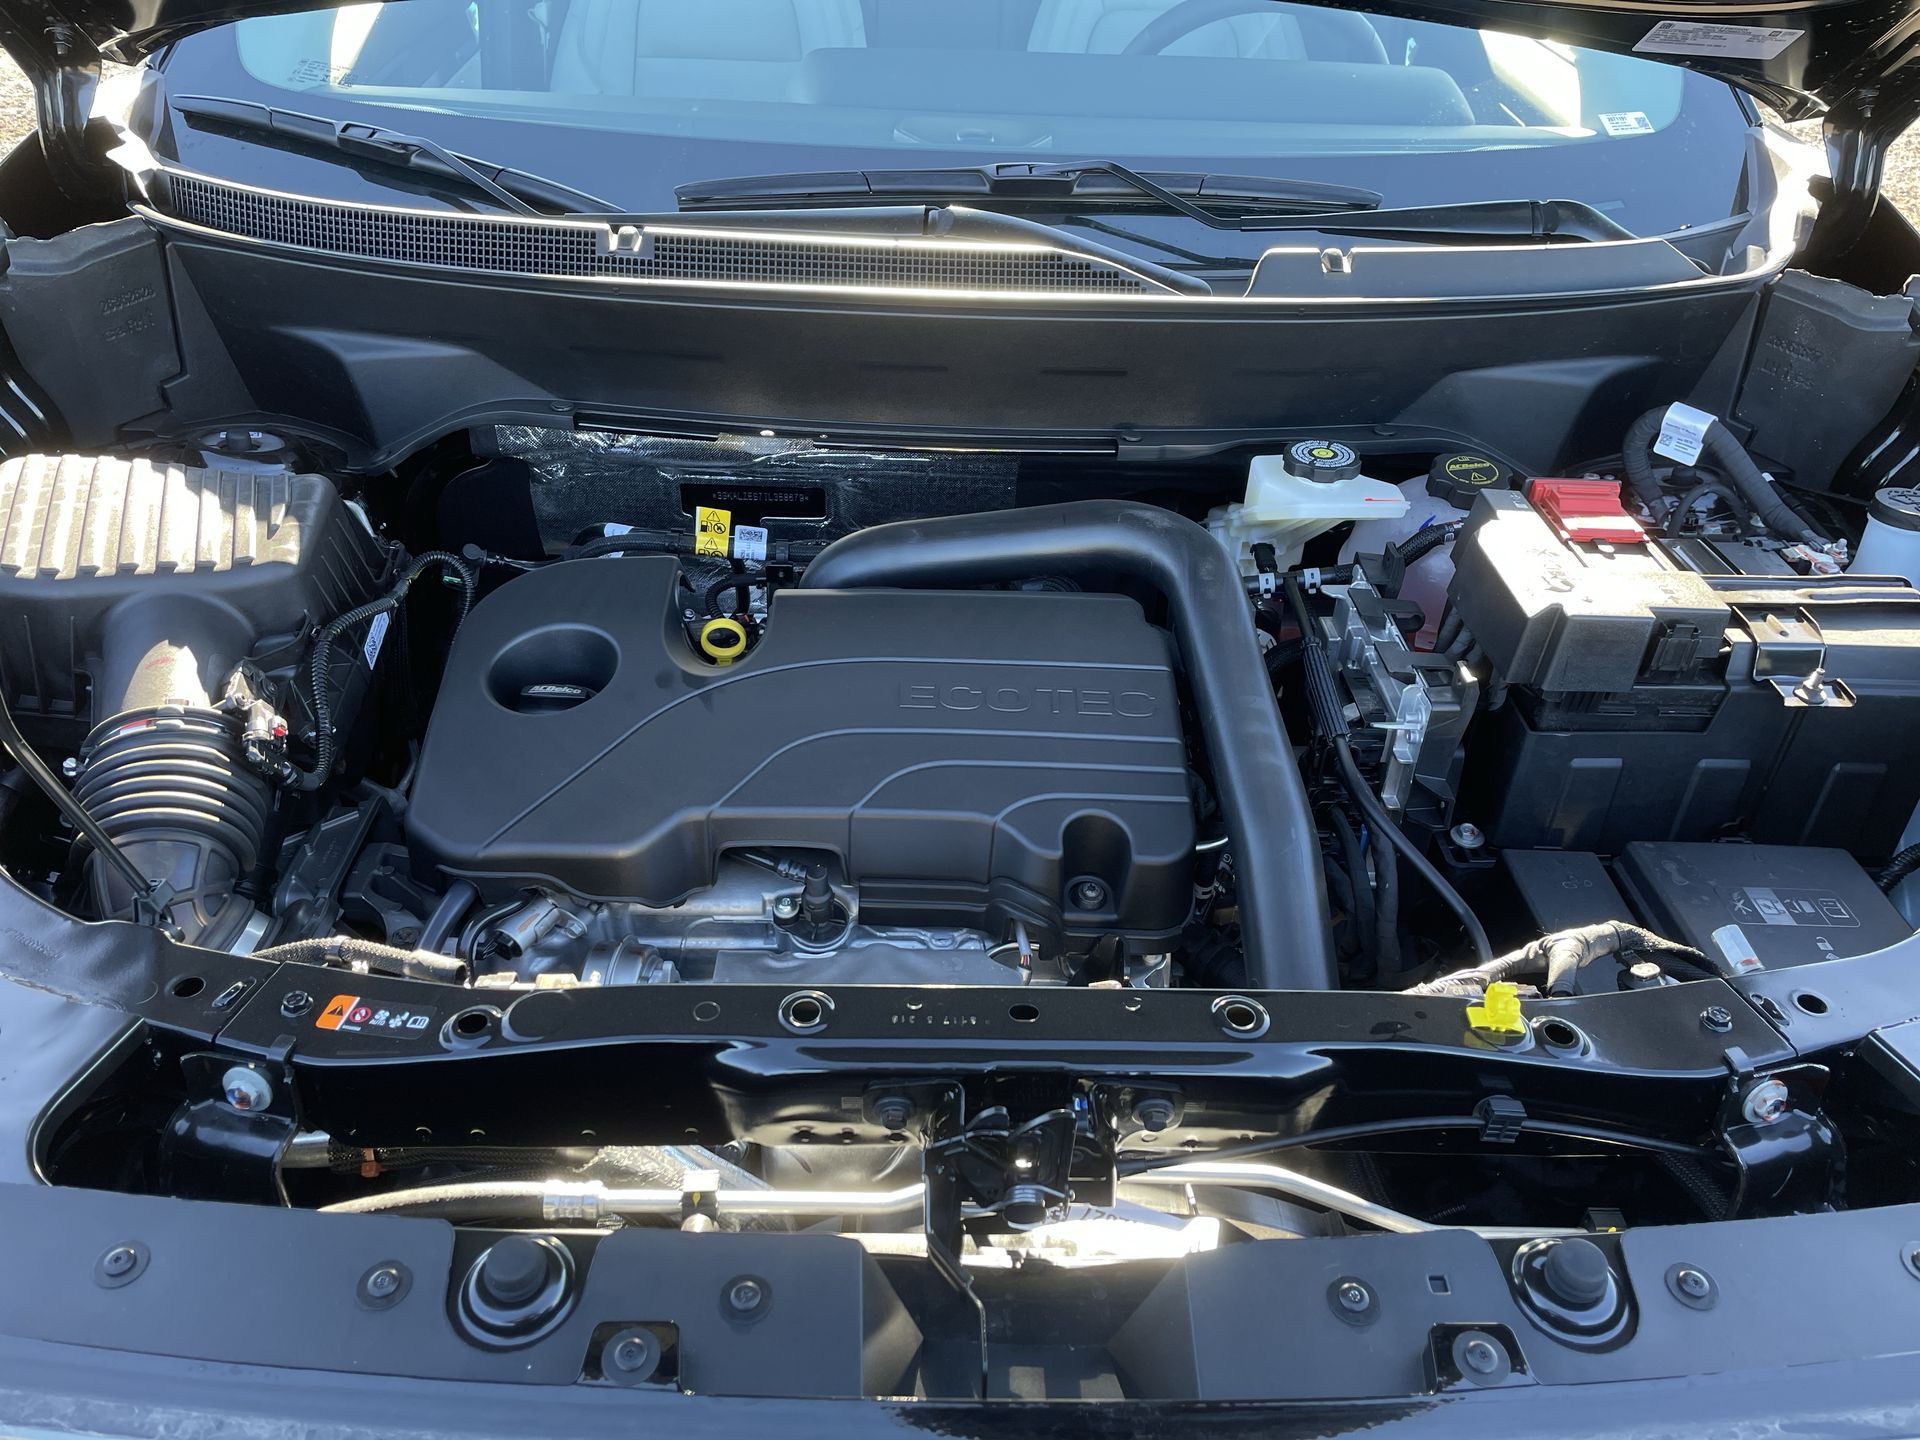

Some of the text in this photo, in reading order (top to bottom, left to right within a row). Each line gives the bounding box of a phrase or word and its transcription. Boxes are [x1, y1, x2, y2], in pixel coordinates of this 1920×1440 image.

[1449, 462, 1490, 470] ACDelco
[528, 685, 582, 694] ACDelco
[900, 684, 1156, 717] ECOTEC
